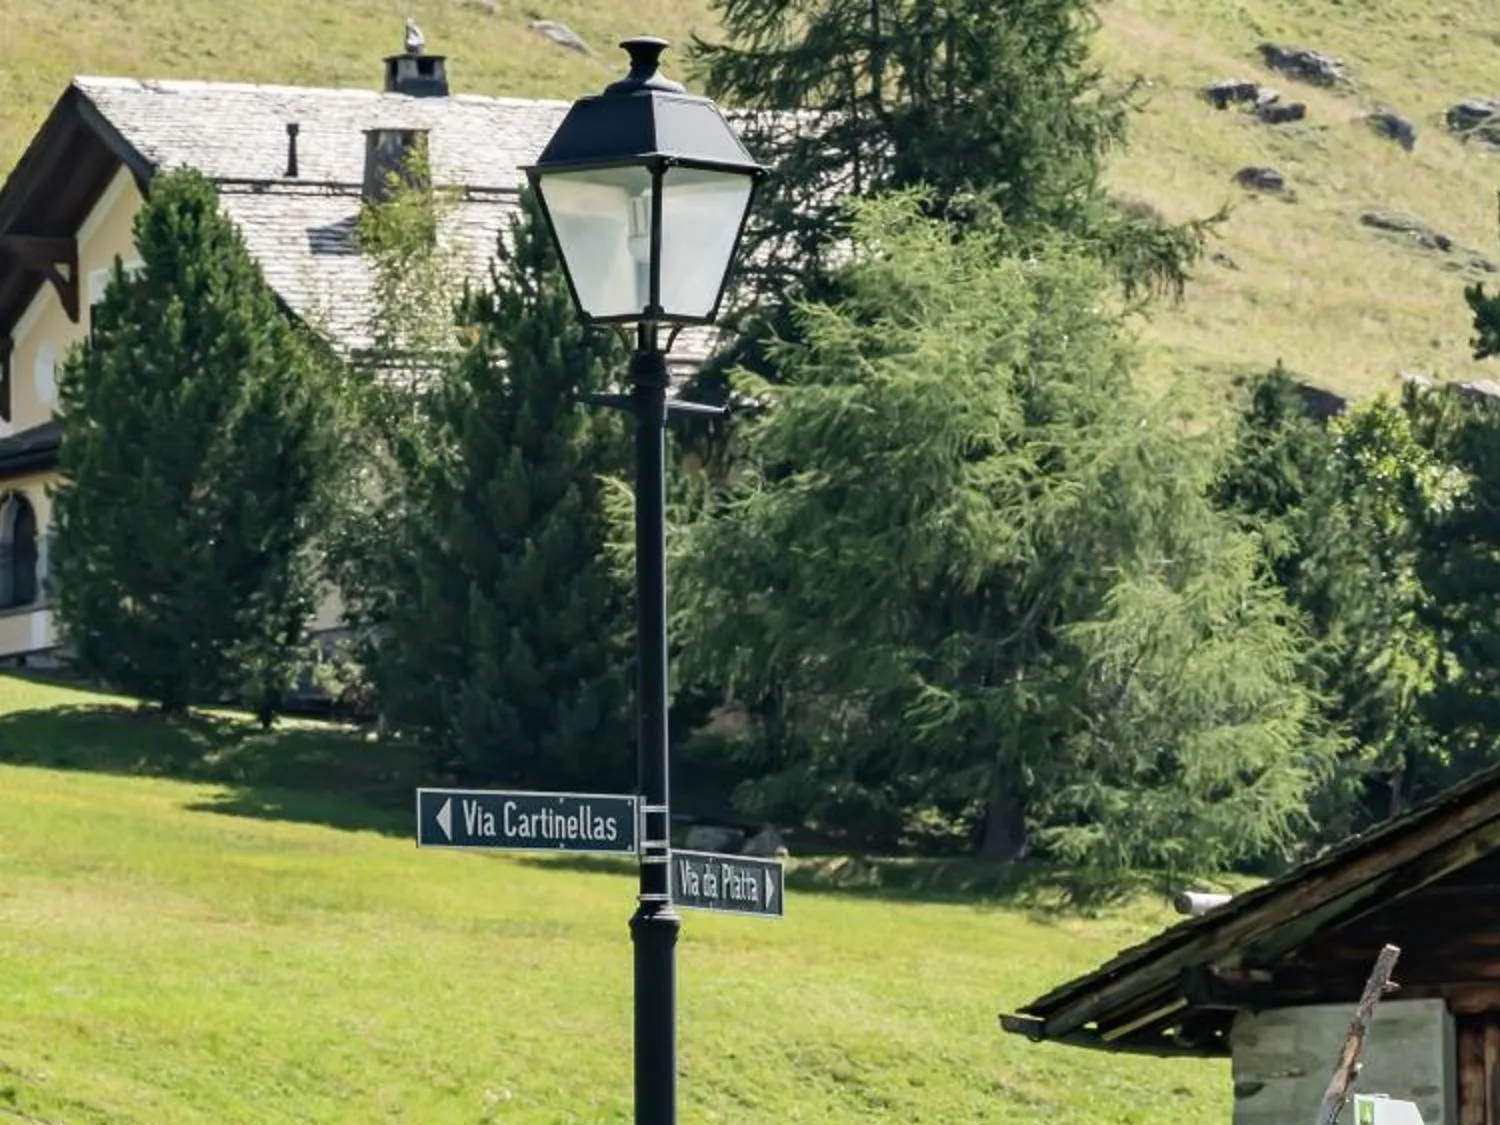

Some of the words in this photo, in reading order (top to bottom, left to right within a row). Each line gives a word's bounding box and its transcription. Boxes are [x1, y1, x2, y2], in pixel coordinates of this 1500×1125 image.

[462, 800, 496, 836] Via
[503, 801, 617, 840] Cartinellas
[678, 858, 700, 896] Via
[703, 863, 719, 898] da
